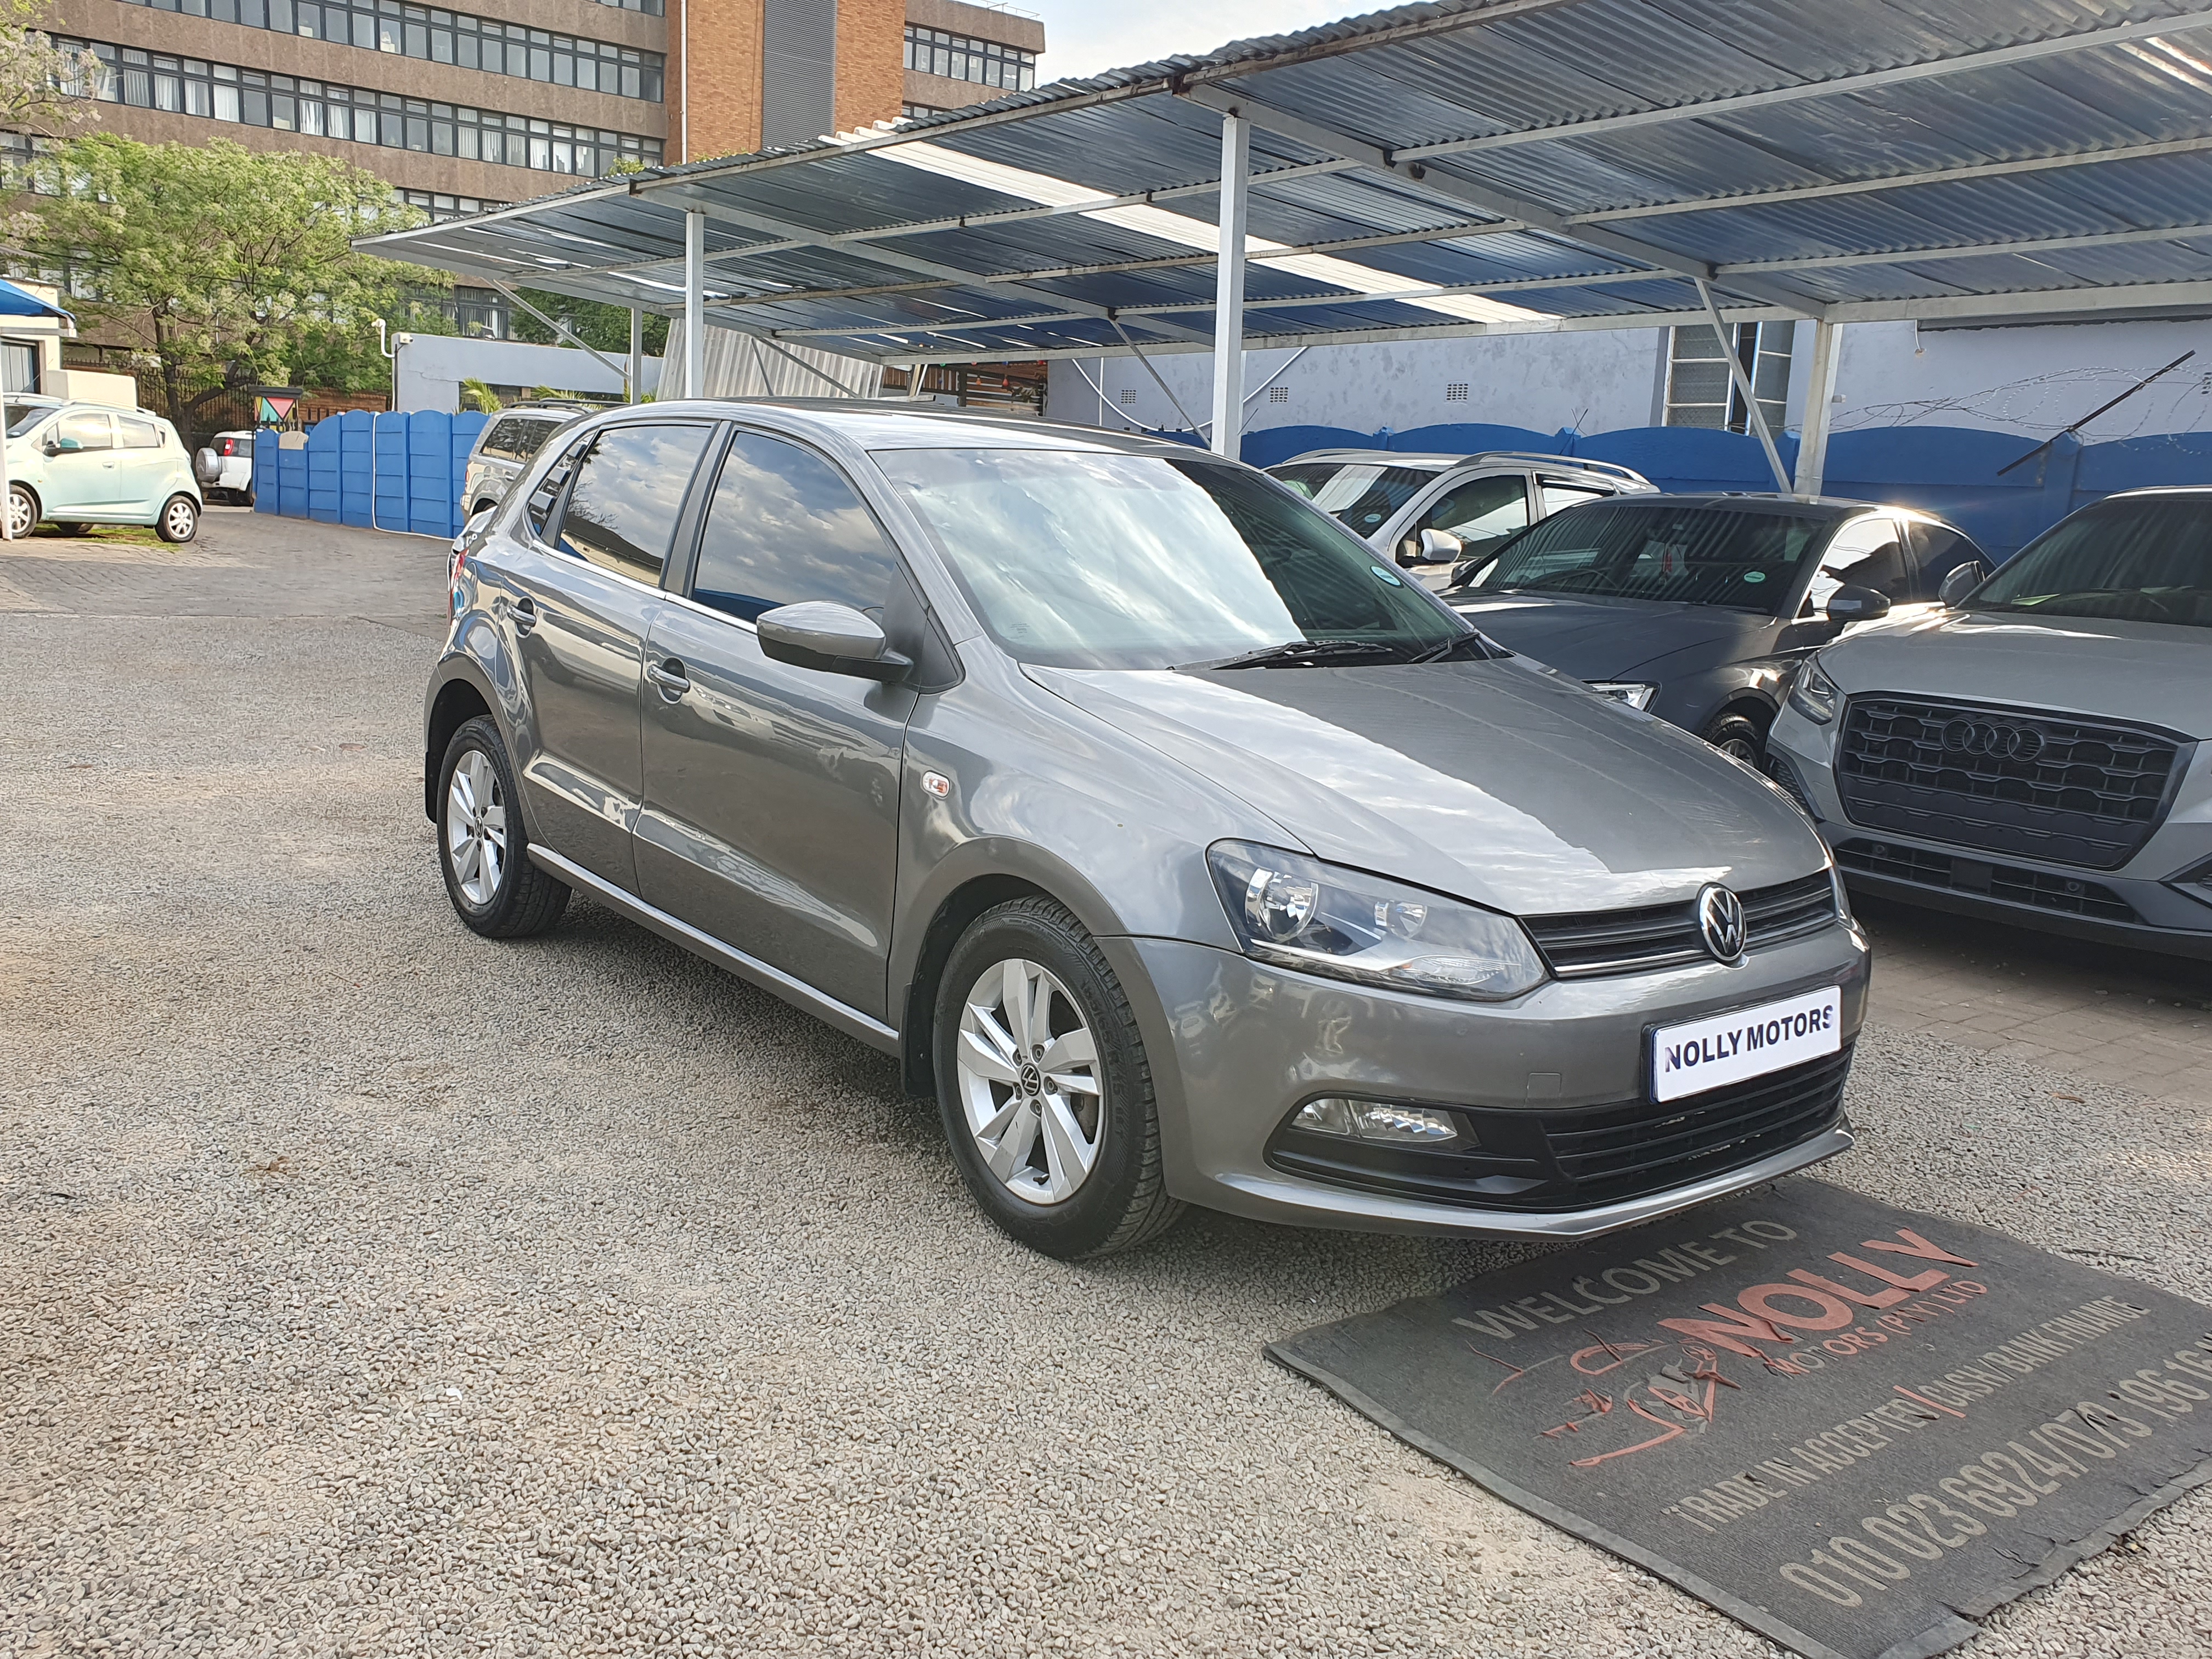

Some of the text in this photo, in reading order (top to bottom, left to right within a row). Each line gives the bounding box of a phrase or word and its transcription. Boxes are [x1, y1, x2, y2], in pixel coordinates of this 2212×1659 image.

[1664, 1005, 1834, 1073] NOLLY MOTORS
[1451, 1221, 1798, 1339] WELCOME TO
[1657, 1227, 1979, 1357] NOLLY
[1763, 1280, 1987, 1379] MOTORS (PTY) LTD
[1661, 1470, 1788, 1532] TRADE
[1755, 1457, 1820, 1487] IN
[1790, 1398, 1940, 1474] ACCEPTED
[1918, 1328, 2074, 1407] CASH/BANK
[2039, 1295, 2152, 1345] FINANCE
[1779, 1536, 1911, 1607] 010
[1861, 1493, 1988, 1560] 023
